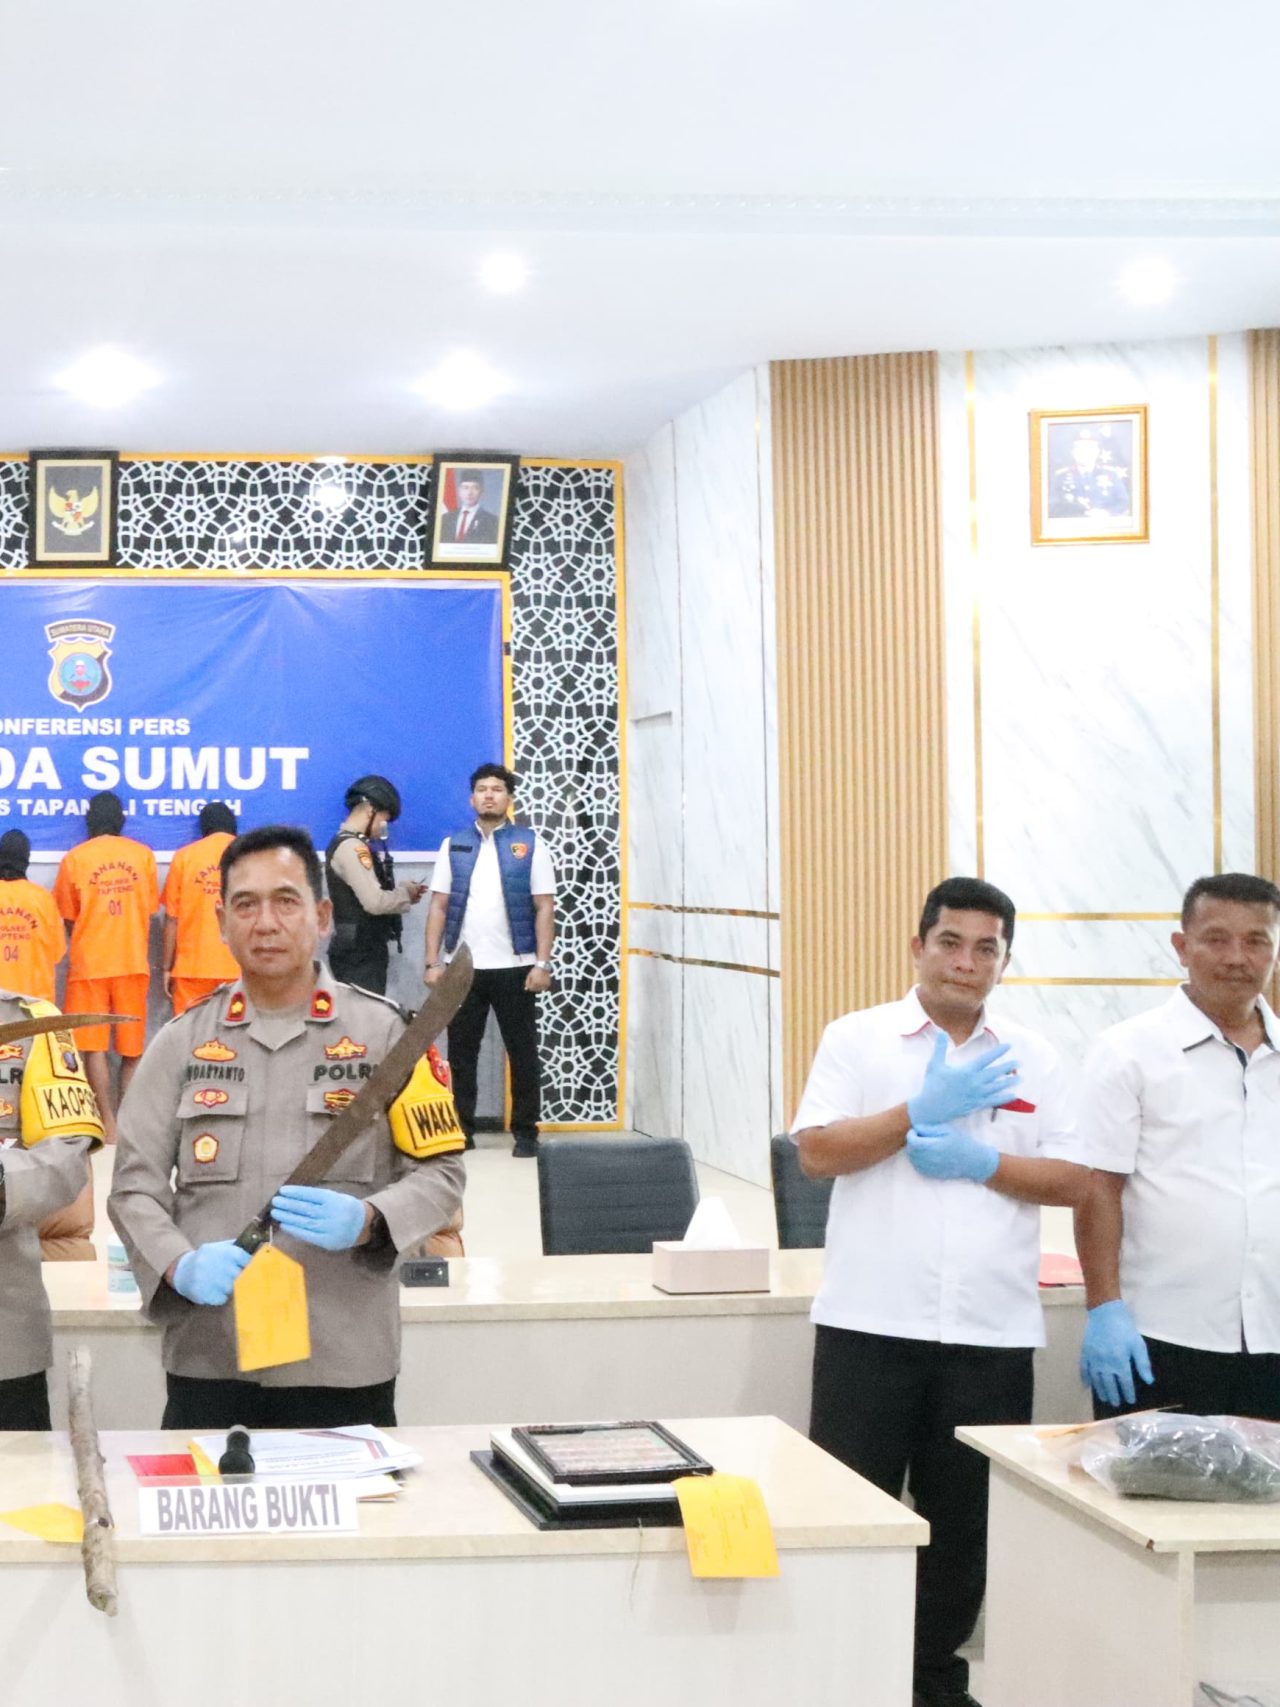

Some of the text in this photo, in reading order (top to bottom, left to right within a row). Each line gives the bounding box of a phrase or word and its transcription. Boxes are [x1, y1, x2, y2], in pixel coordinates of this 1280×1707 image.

[130, 718, 191, 736] PERS
[82, 746, 309, 791] SUMUT
[17, 799, 136, 816] TAPANI
[144, 798, 242, 816] TENGH
[157, 1484, 341, 1531] BARANG BUKTI
